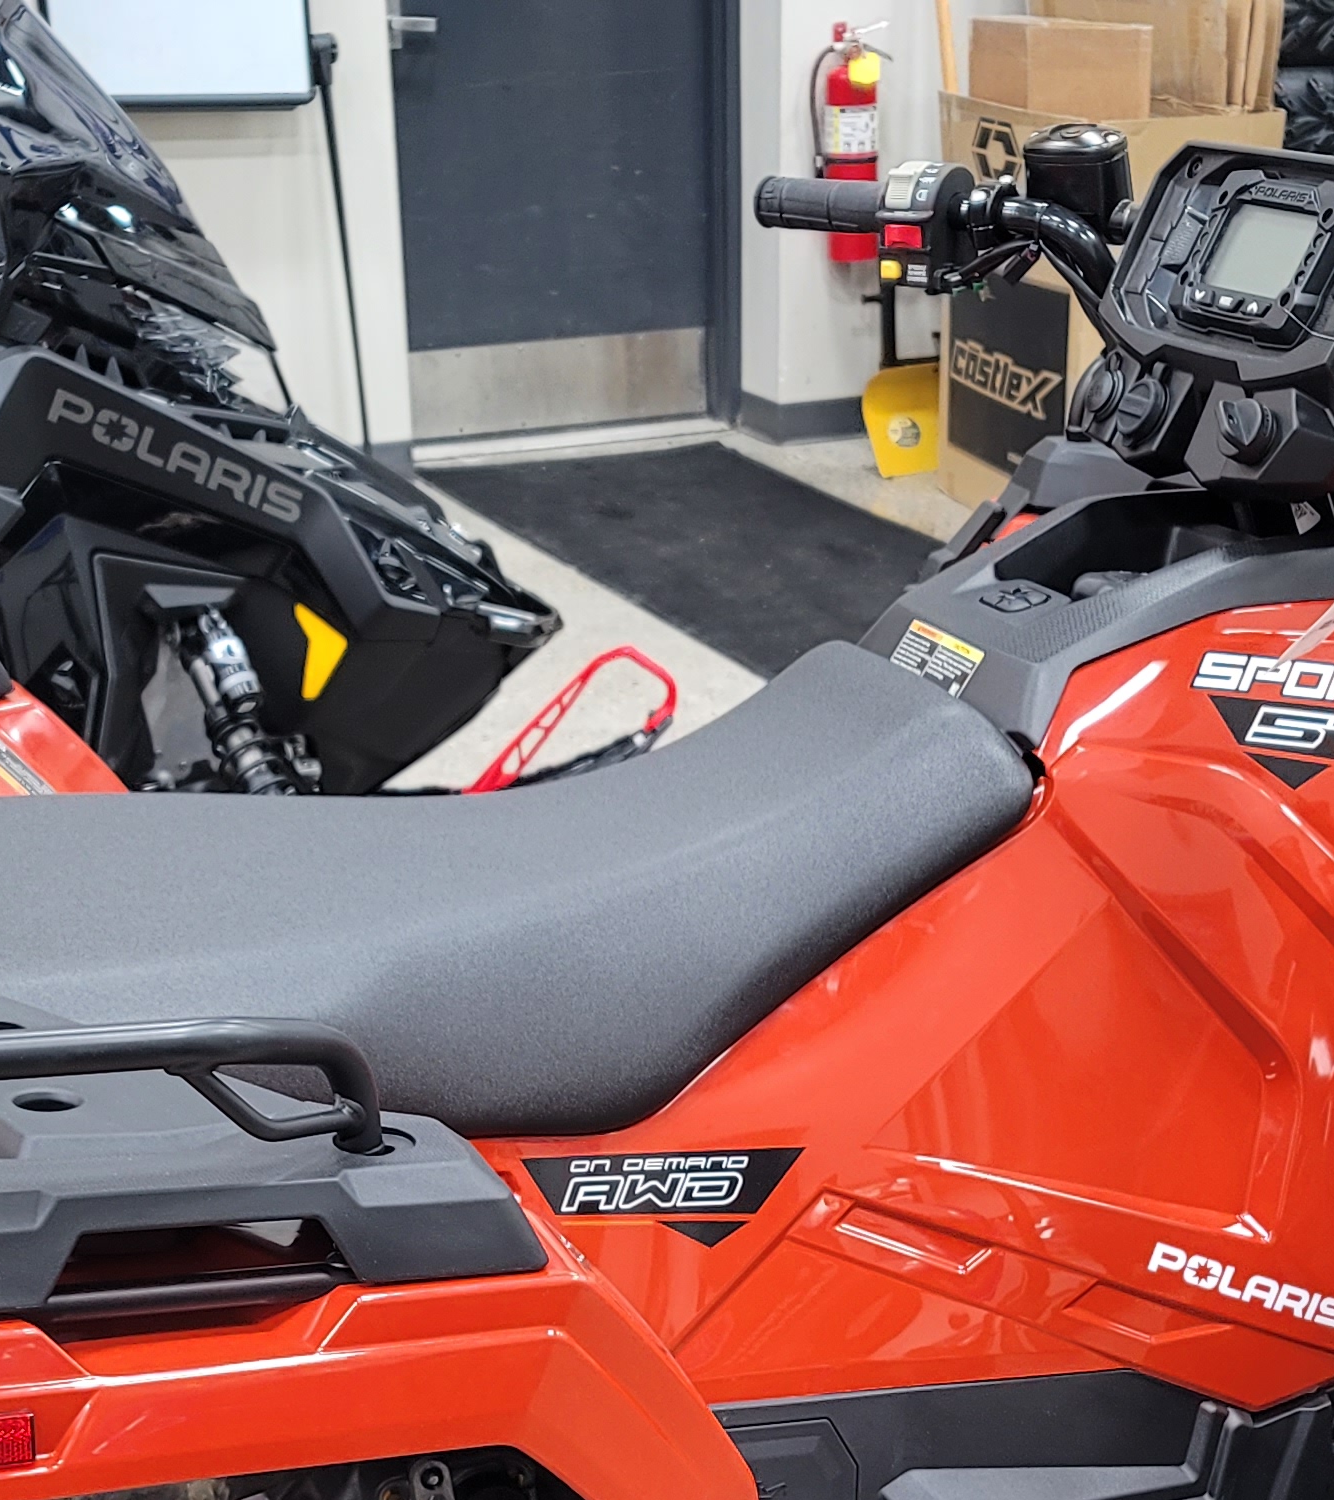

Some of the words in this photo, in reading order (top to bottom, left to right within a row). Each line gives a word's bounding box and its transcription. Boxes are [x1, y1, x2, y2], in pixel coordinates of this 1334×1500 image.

[1255, 184, 1310, 203] POLARIS
[46, 387, 303, 524] POLARIS
[569, 1158, 611, 1173] ON
[622, 1156, 749, 1171] DEMAND
[560, 1172, 744, 1213] AWD
